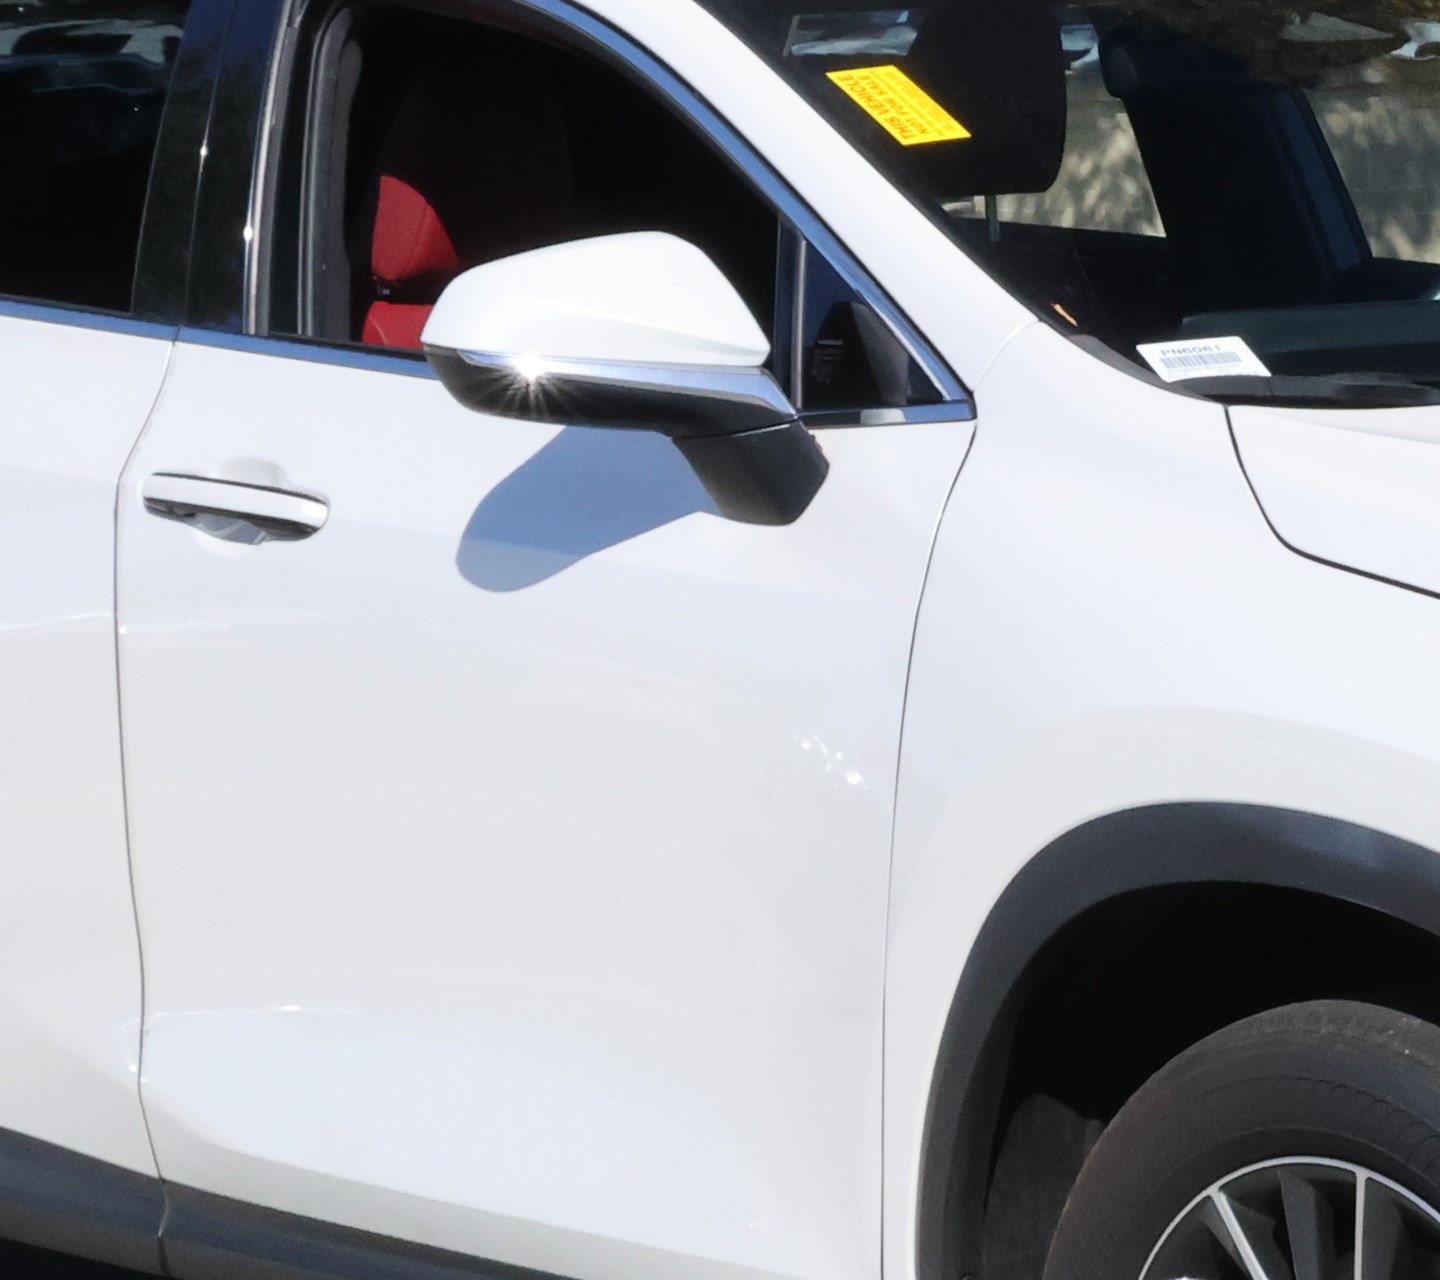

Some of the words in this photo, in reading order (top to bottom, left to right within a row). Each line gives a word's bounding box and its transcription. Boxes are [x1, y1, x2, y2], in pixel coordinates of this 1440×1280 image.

[837, 75, 889, 115] VEHICLE
[858, 75, 887, 96] SALE
[884, 98, 909, 115] FOR
[885, 117, 917, 139] THIS
[904, 118, 929, 135] NOT
